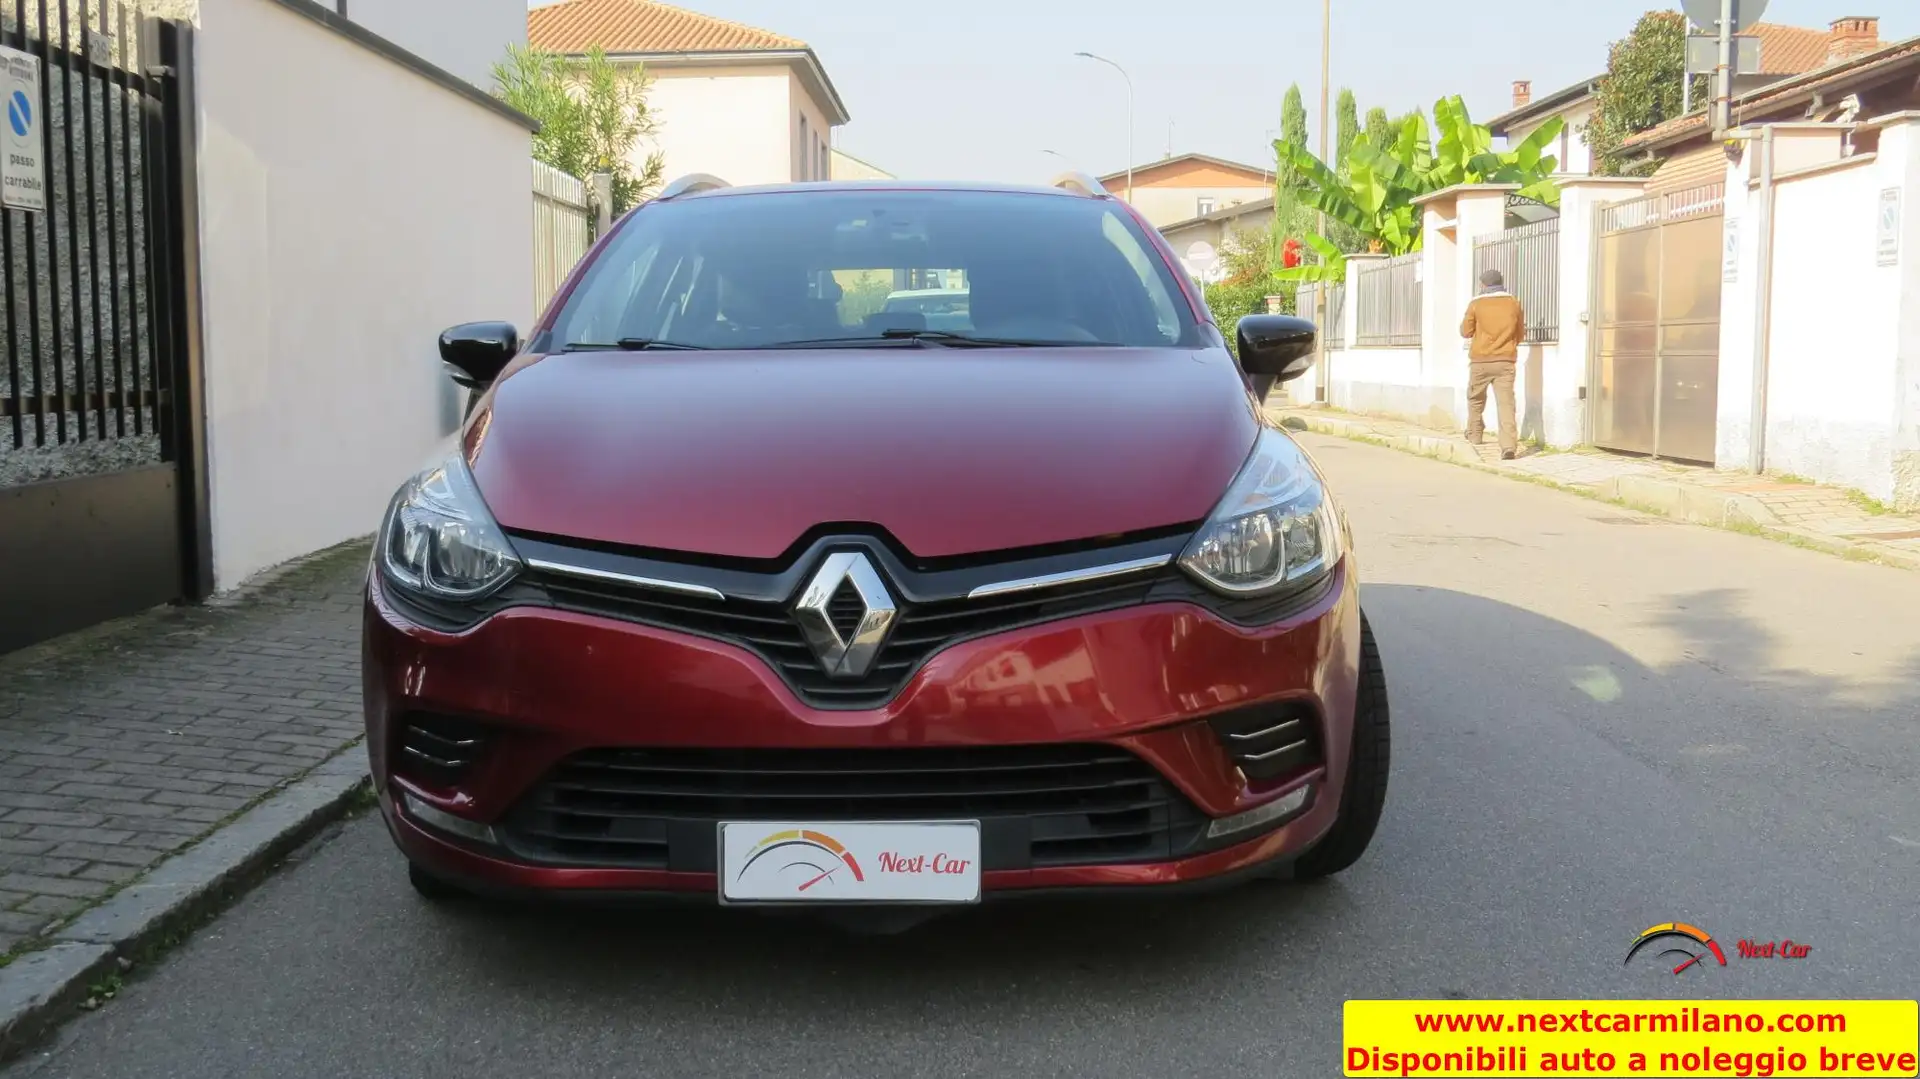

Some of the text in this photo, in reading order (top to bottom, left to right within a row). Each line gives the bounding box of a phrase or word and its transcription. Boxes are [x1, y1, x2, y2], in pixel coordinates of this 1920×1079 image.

[10, 153, 35, 168] passo
[5, 175, 41, 191] carrabile
[878, 852, 970, 874] Next-Car
